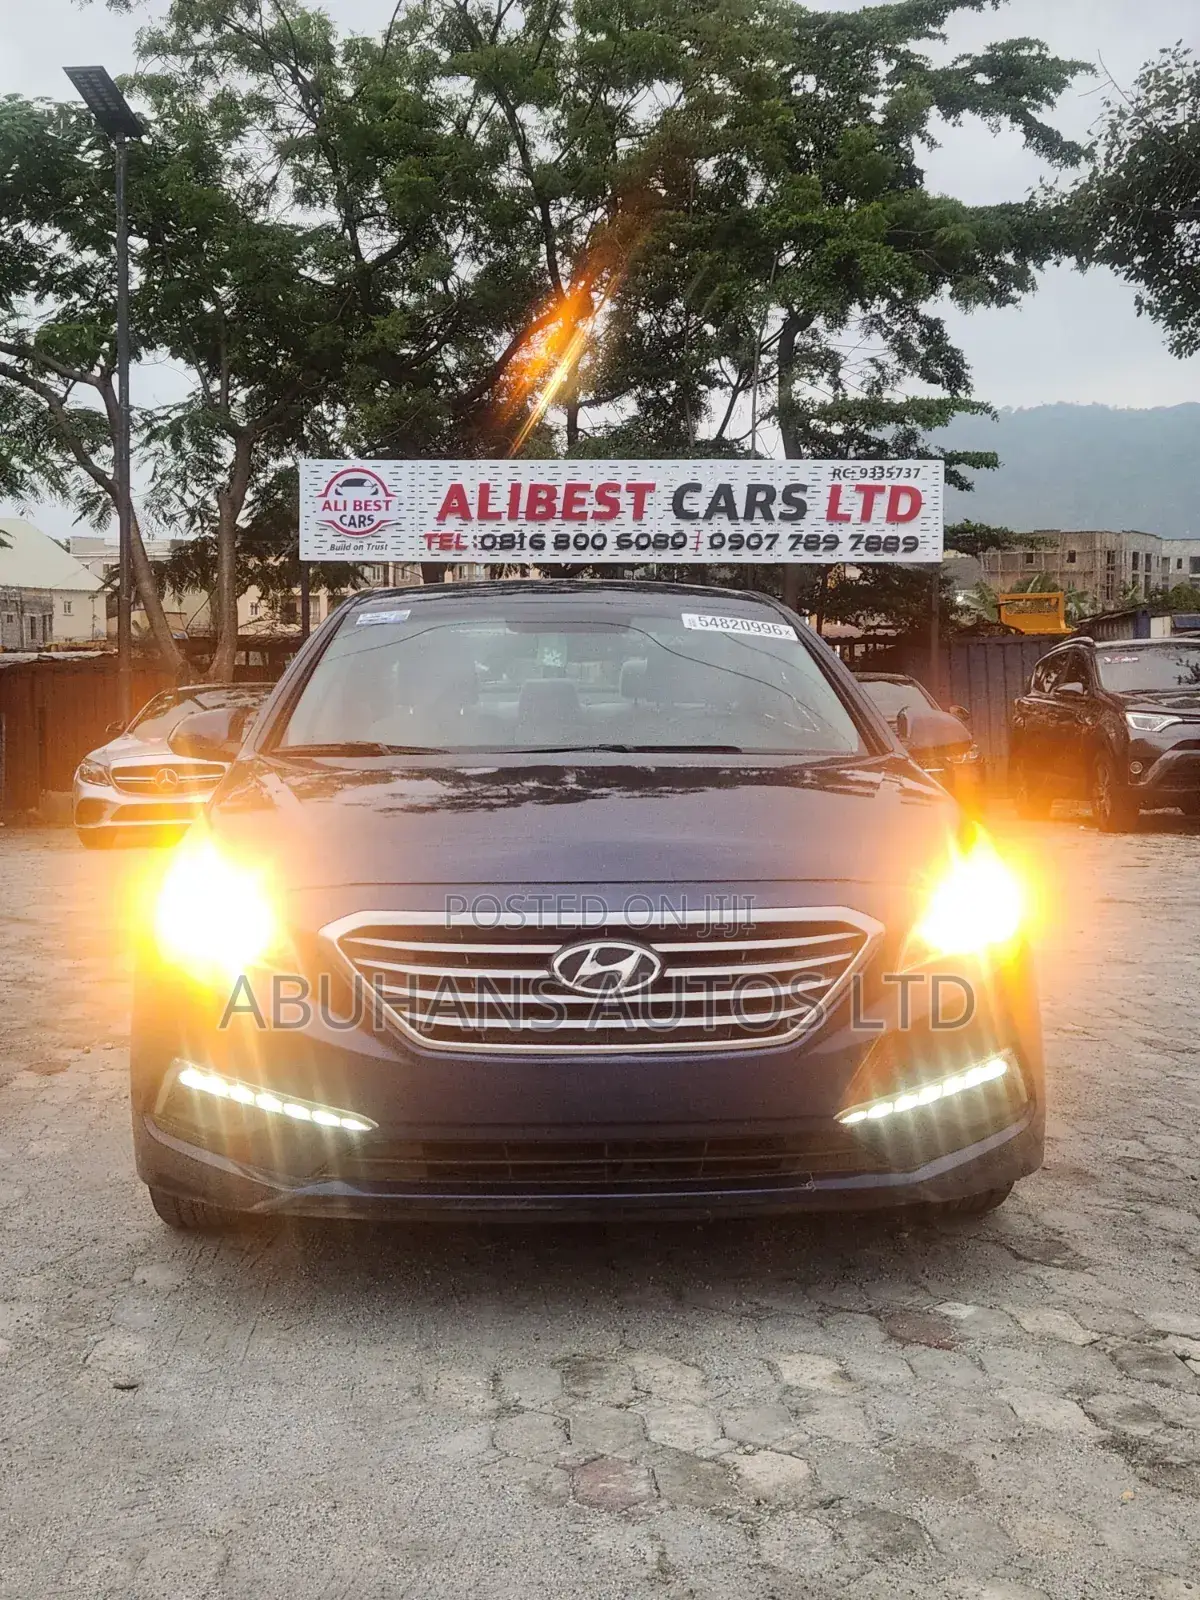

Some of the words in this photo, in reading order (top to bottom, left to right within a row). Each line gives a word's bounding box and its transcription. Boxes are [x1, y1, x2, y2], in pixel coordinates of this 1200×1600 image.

[860, 467, 921, 479] 9335737
[322, 500, 347, 511] ALI
[353, 500, 392, 511] BEST
[436, 482, 656, 522] ALIBEST
[671, 482, 808, 522] CARS
[826, 484, 923, 523] LTD
[339, 514, 375, 528] CARS
[329, 543, 352, 552] Build
[366, 543, 388, 551] Trust
[553, 533, 608, 550] 800
[616, 532, 688, 550] 6080
[709, 533, 780, 551] 0907
[788, 533, 840, 552] 789
[848, 533, 919, 554] 7889
